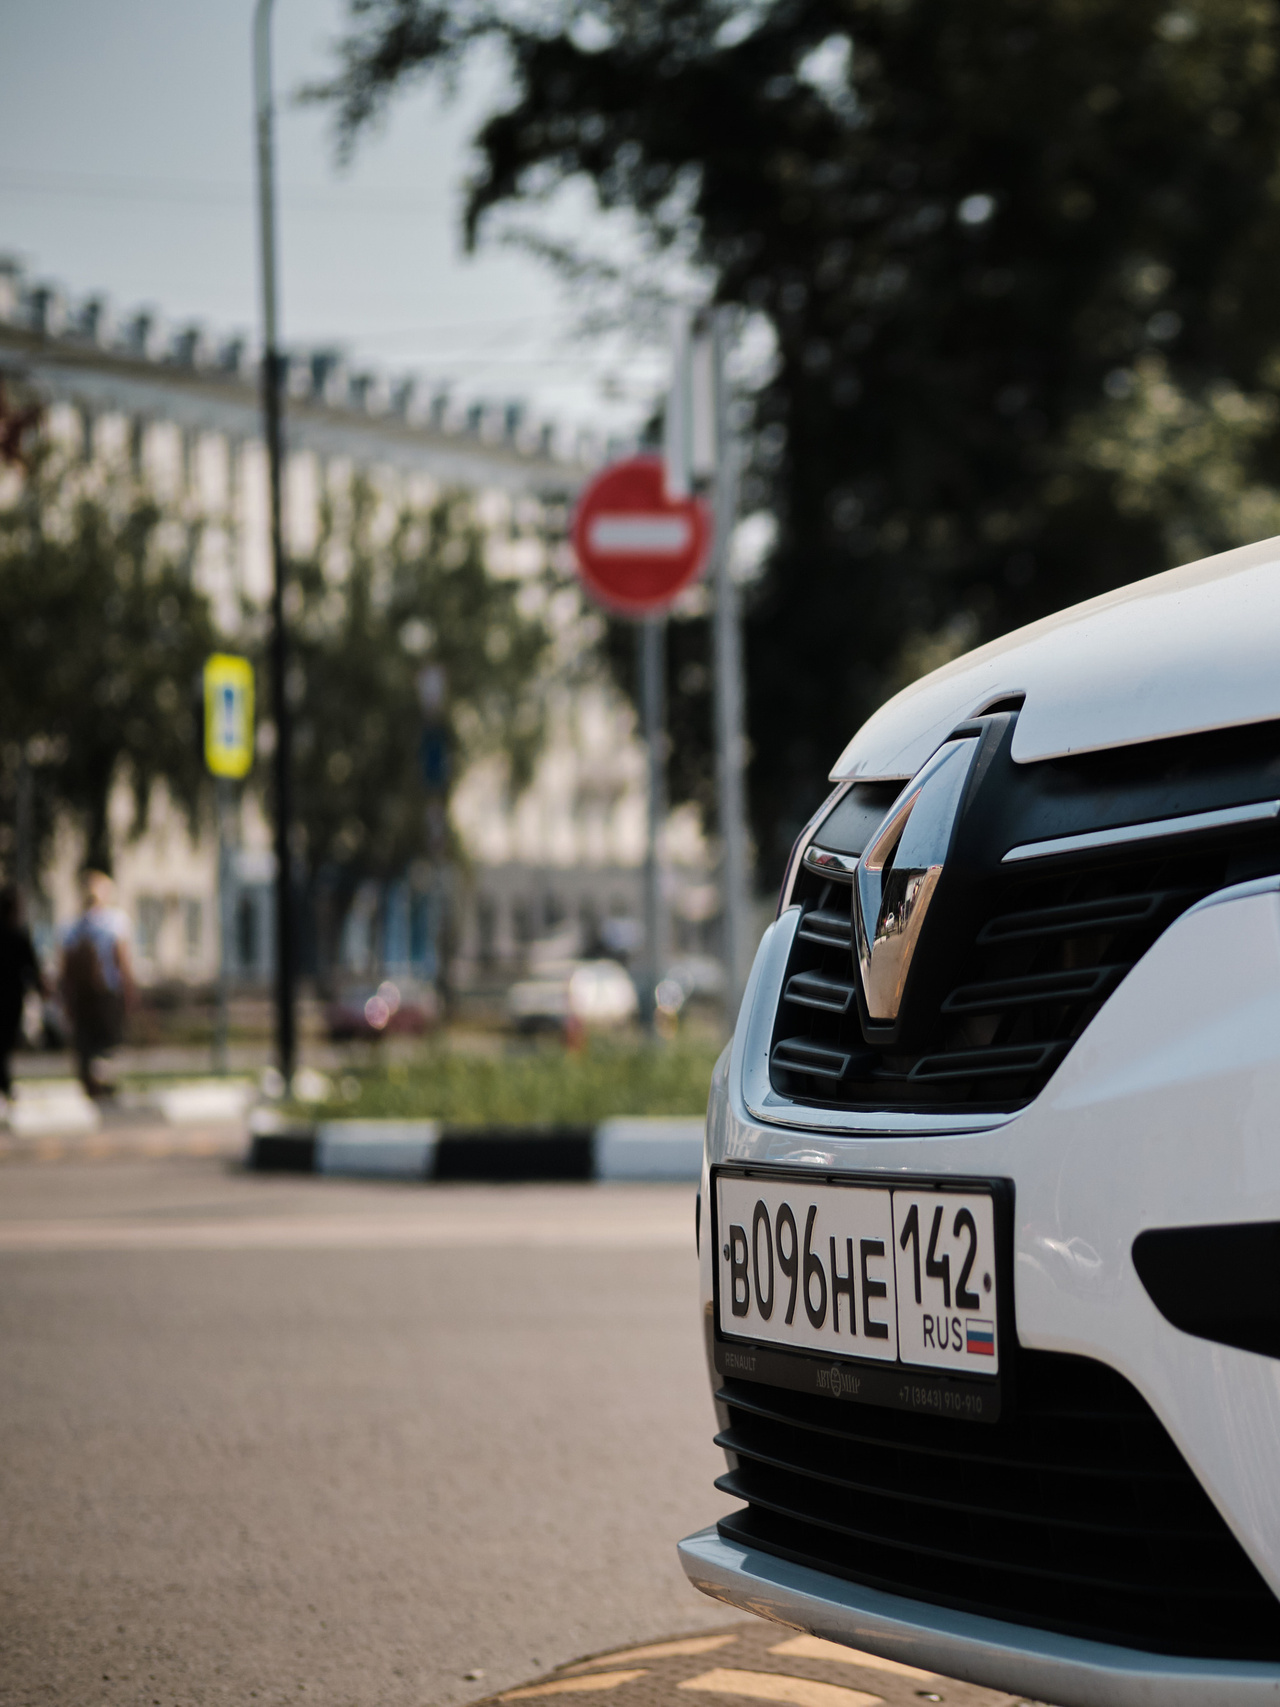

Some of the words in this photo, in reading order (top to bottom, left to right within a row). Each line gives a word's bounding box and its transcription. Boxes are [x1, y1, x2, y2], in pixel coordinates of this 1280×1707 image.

[900, 1204, 980, 1309] 142
[922, 1314, 963, 1351] RUS
[725, 1352, 756, 1371] RENAULT
